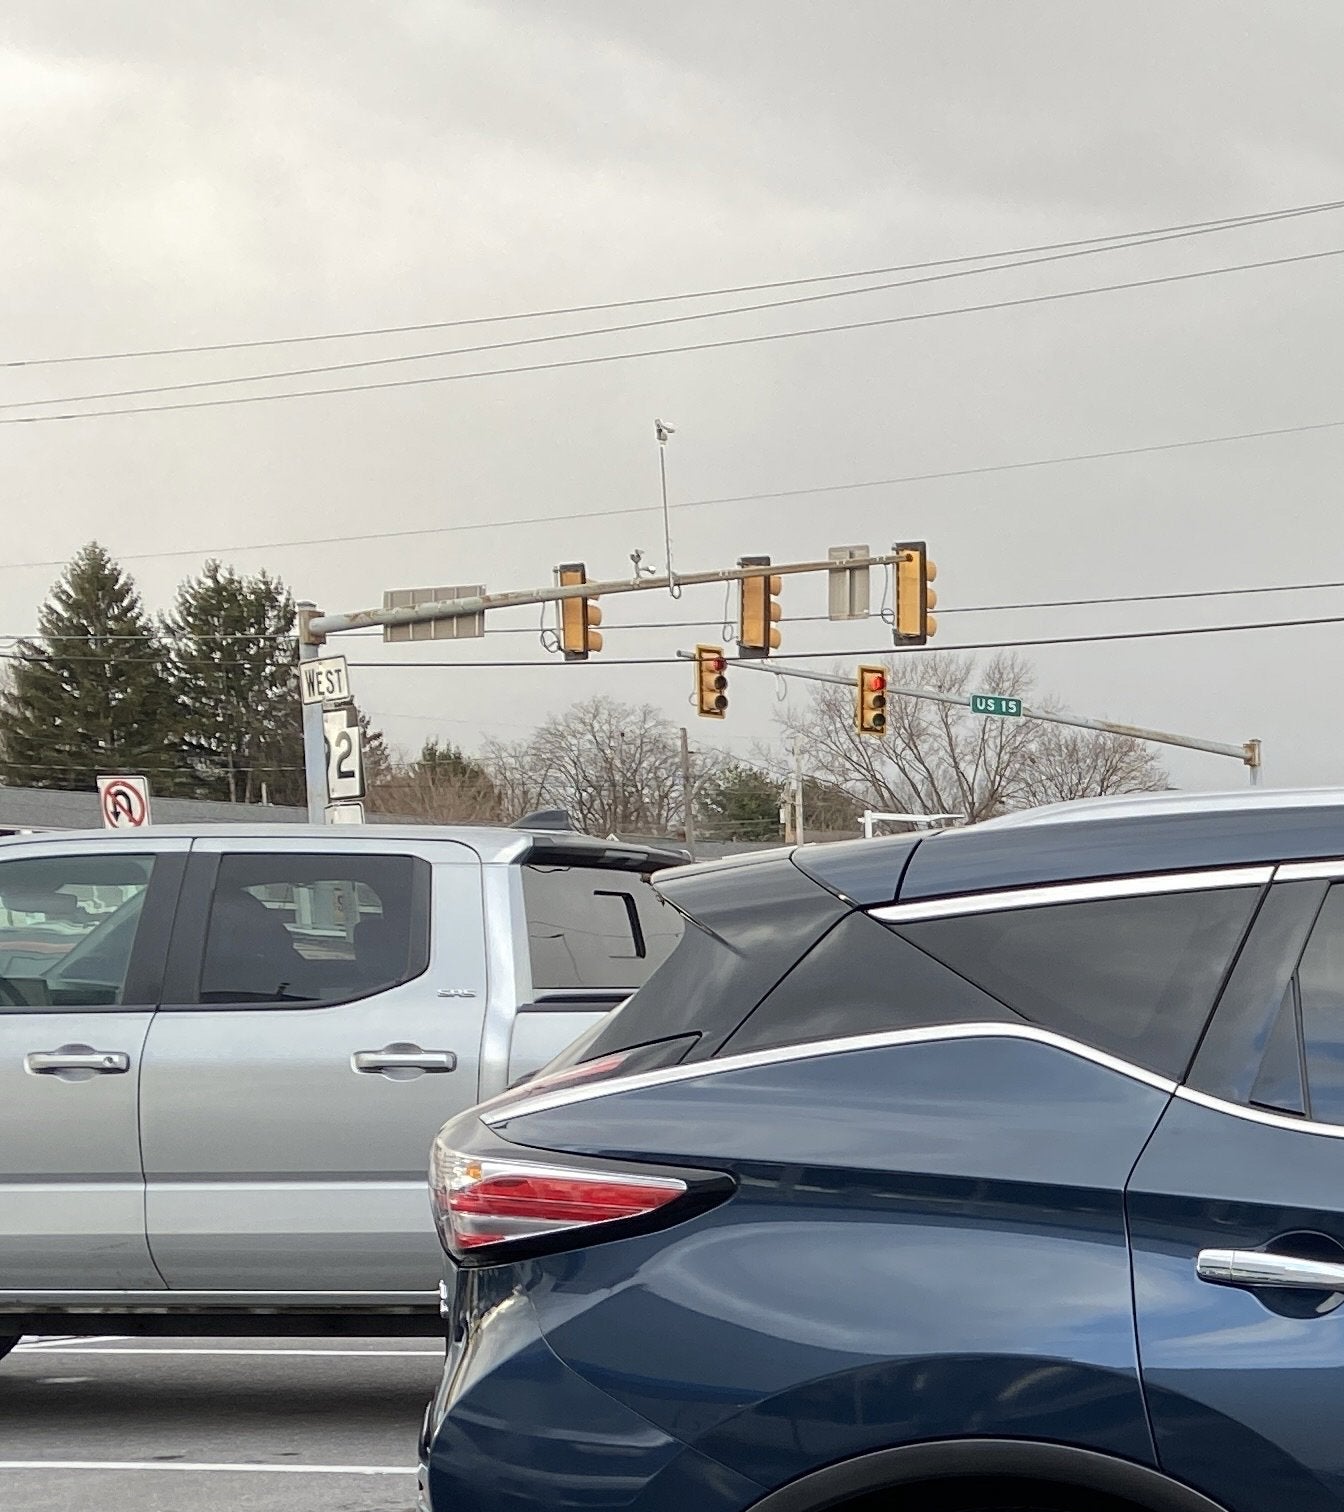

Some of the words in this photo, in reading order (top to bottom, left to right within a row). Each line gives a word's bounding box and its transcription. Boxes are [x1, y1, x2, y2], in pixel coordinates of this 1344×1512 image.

[304, 667, 343, 698] WEST
[976, 698, 995, 711] US
[1001, 700, 1017, 713] 15
